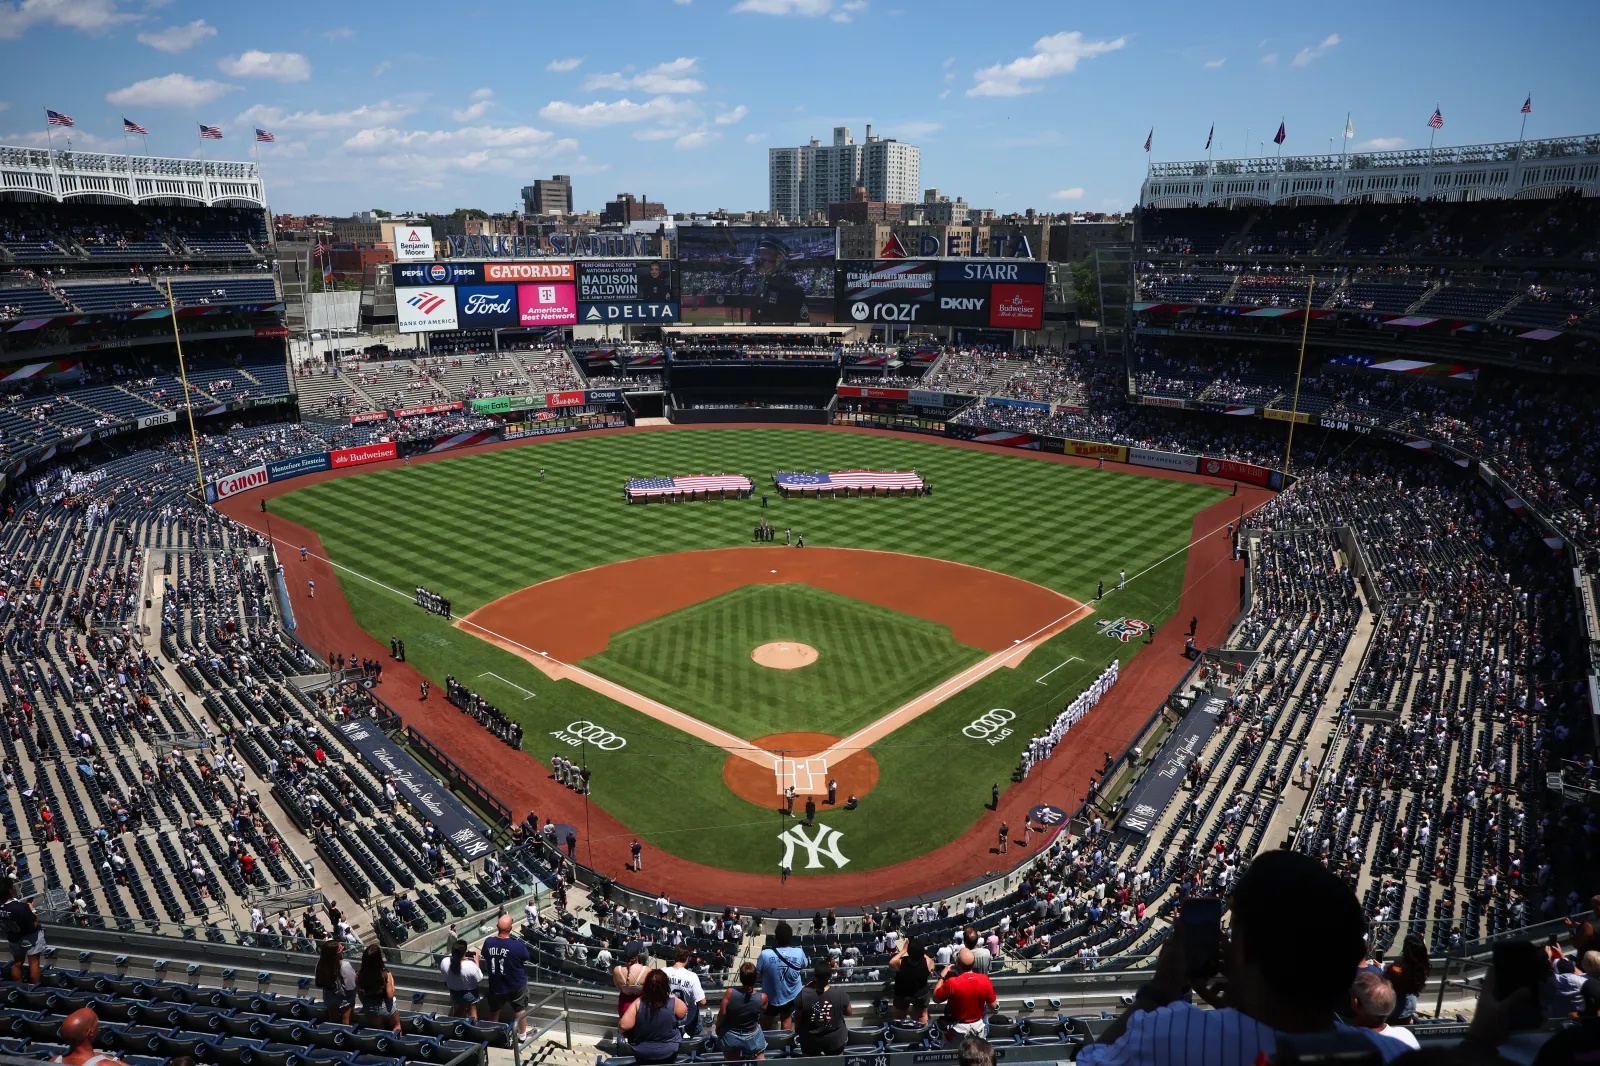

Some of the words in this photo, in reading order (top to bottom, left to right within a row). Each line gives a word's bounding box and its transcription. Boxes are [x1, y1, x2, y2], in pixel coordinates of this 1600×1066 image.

[400, 242, 429, 251] Benjamin
[448, 234, 539, 257] YANKEE
[549, 233, 648, 257] STADIUM
[920, 235, 1032, 257] DELTA
[490, 265, 570, 278] GATORADE
[963, 264, 1018, 280] STARR
[581, 274, 638, 285] MADISON
[582, 285, 638, 294] BALDWIN
[464, 294, 511, 315] Ford
[941, 297, 985, 310] DKNY
[999, 304, 1034, 312] Budweiser
[528, 306, 568, 314] America's
[608, 305, 673, 319] DELTA
[873, 303, 920, 321] razr
[491, 402, 508, 410] Eats
[586, 404, 607, 413] ABOVE
[145, 415, 168, 426] ORIS
[1320, 419, 1335, 429] 1:26
[1337, 421, 1348, 431] PM
[109, 428, 117, 436] PM
[350, 450, 394, 461] Budweiser
[1155, 456, 1182, 465] AMERICA
[271, 461, 301, 473] Montefiore
[301, 457, 326, 467] Einstein
[1239, 466, 1263, 476] WEBB
[218, 470, 267, 496] Canon
[549, 731, 584, 747] Audi
[986, 727, 1015, 746] Audi
[416, 793, 444, 817] Stadium
